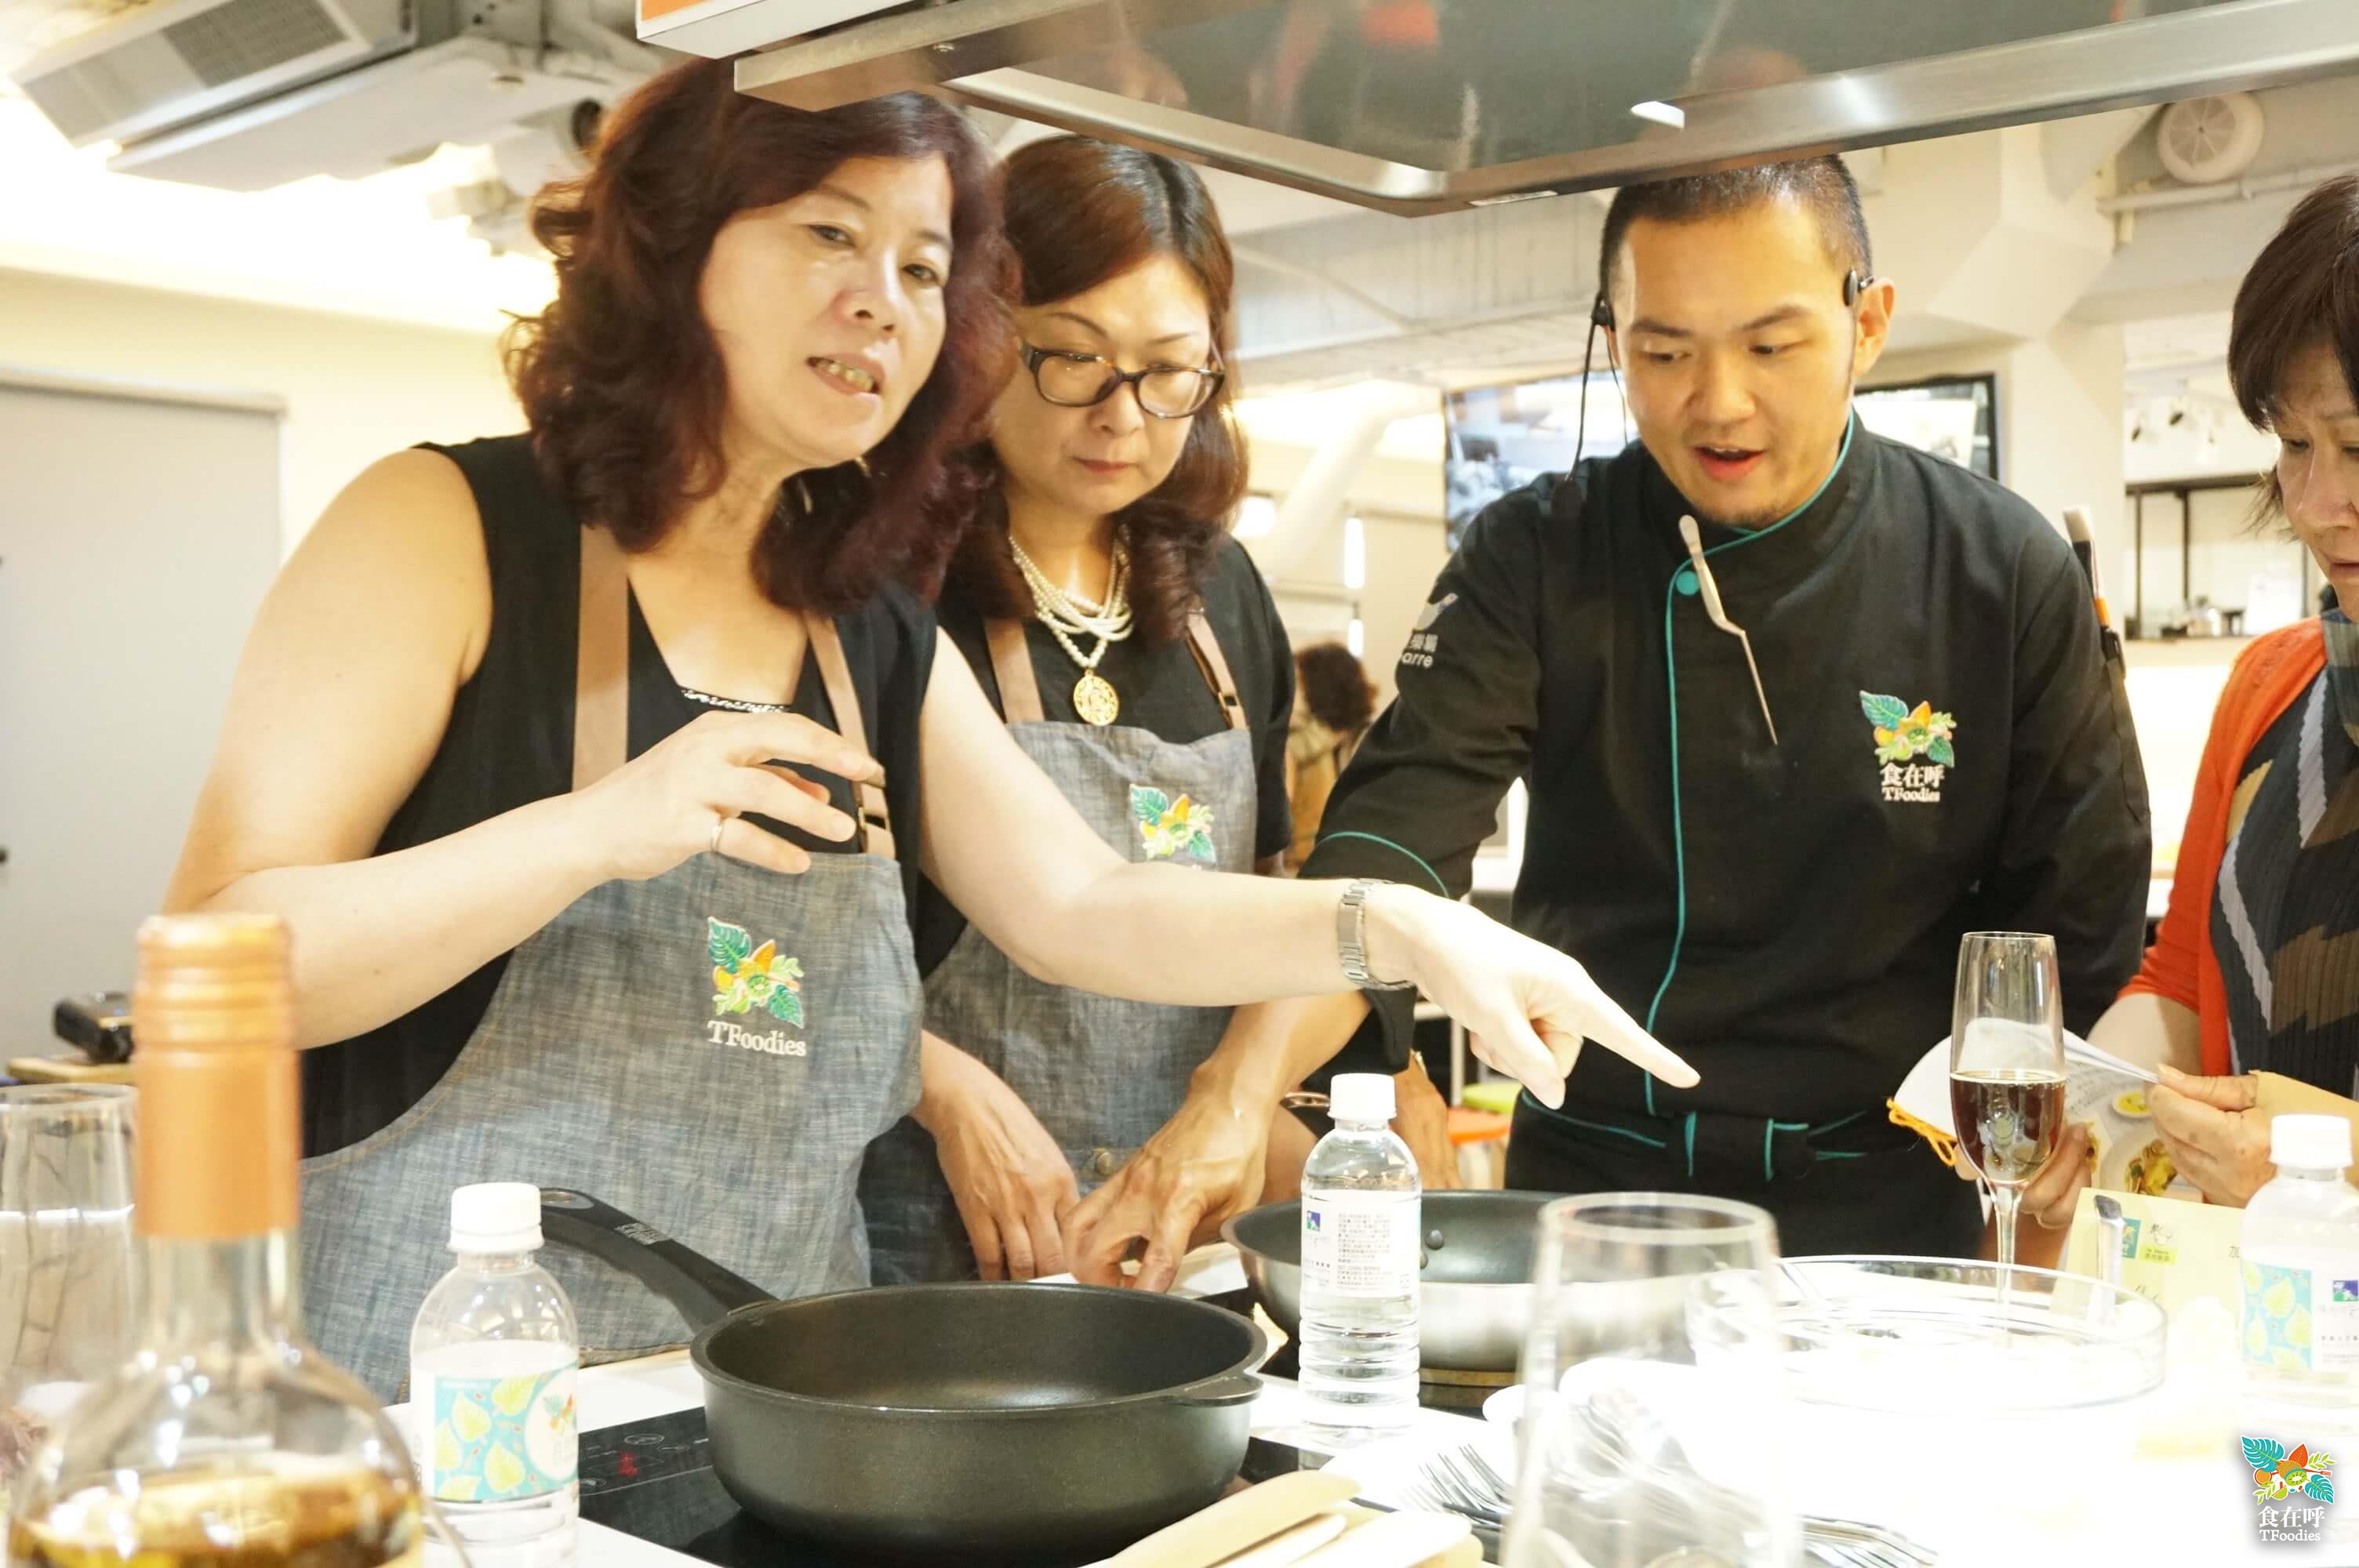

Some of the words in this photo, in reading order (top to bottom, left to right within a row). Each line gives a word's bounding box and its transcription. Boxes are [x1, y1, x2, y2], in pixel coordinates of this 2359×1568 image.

[1880, 762, 1945, 788] 食在呼
[1882, 786, 1941, 803] TFoodies
[707, 1020, 807, 1057] TFoodies
